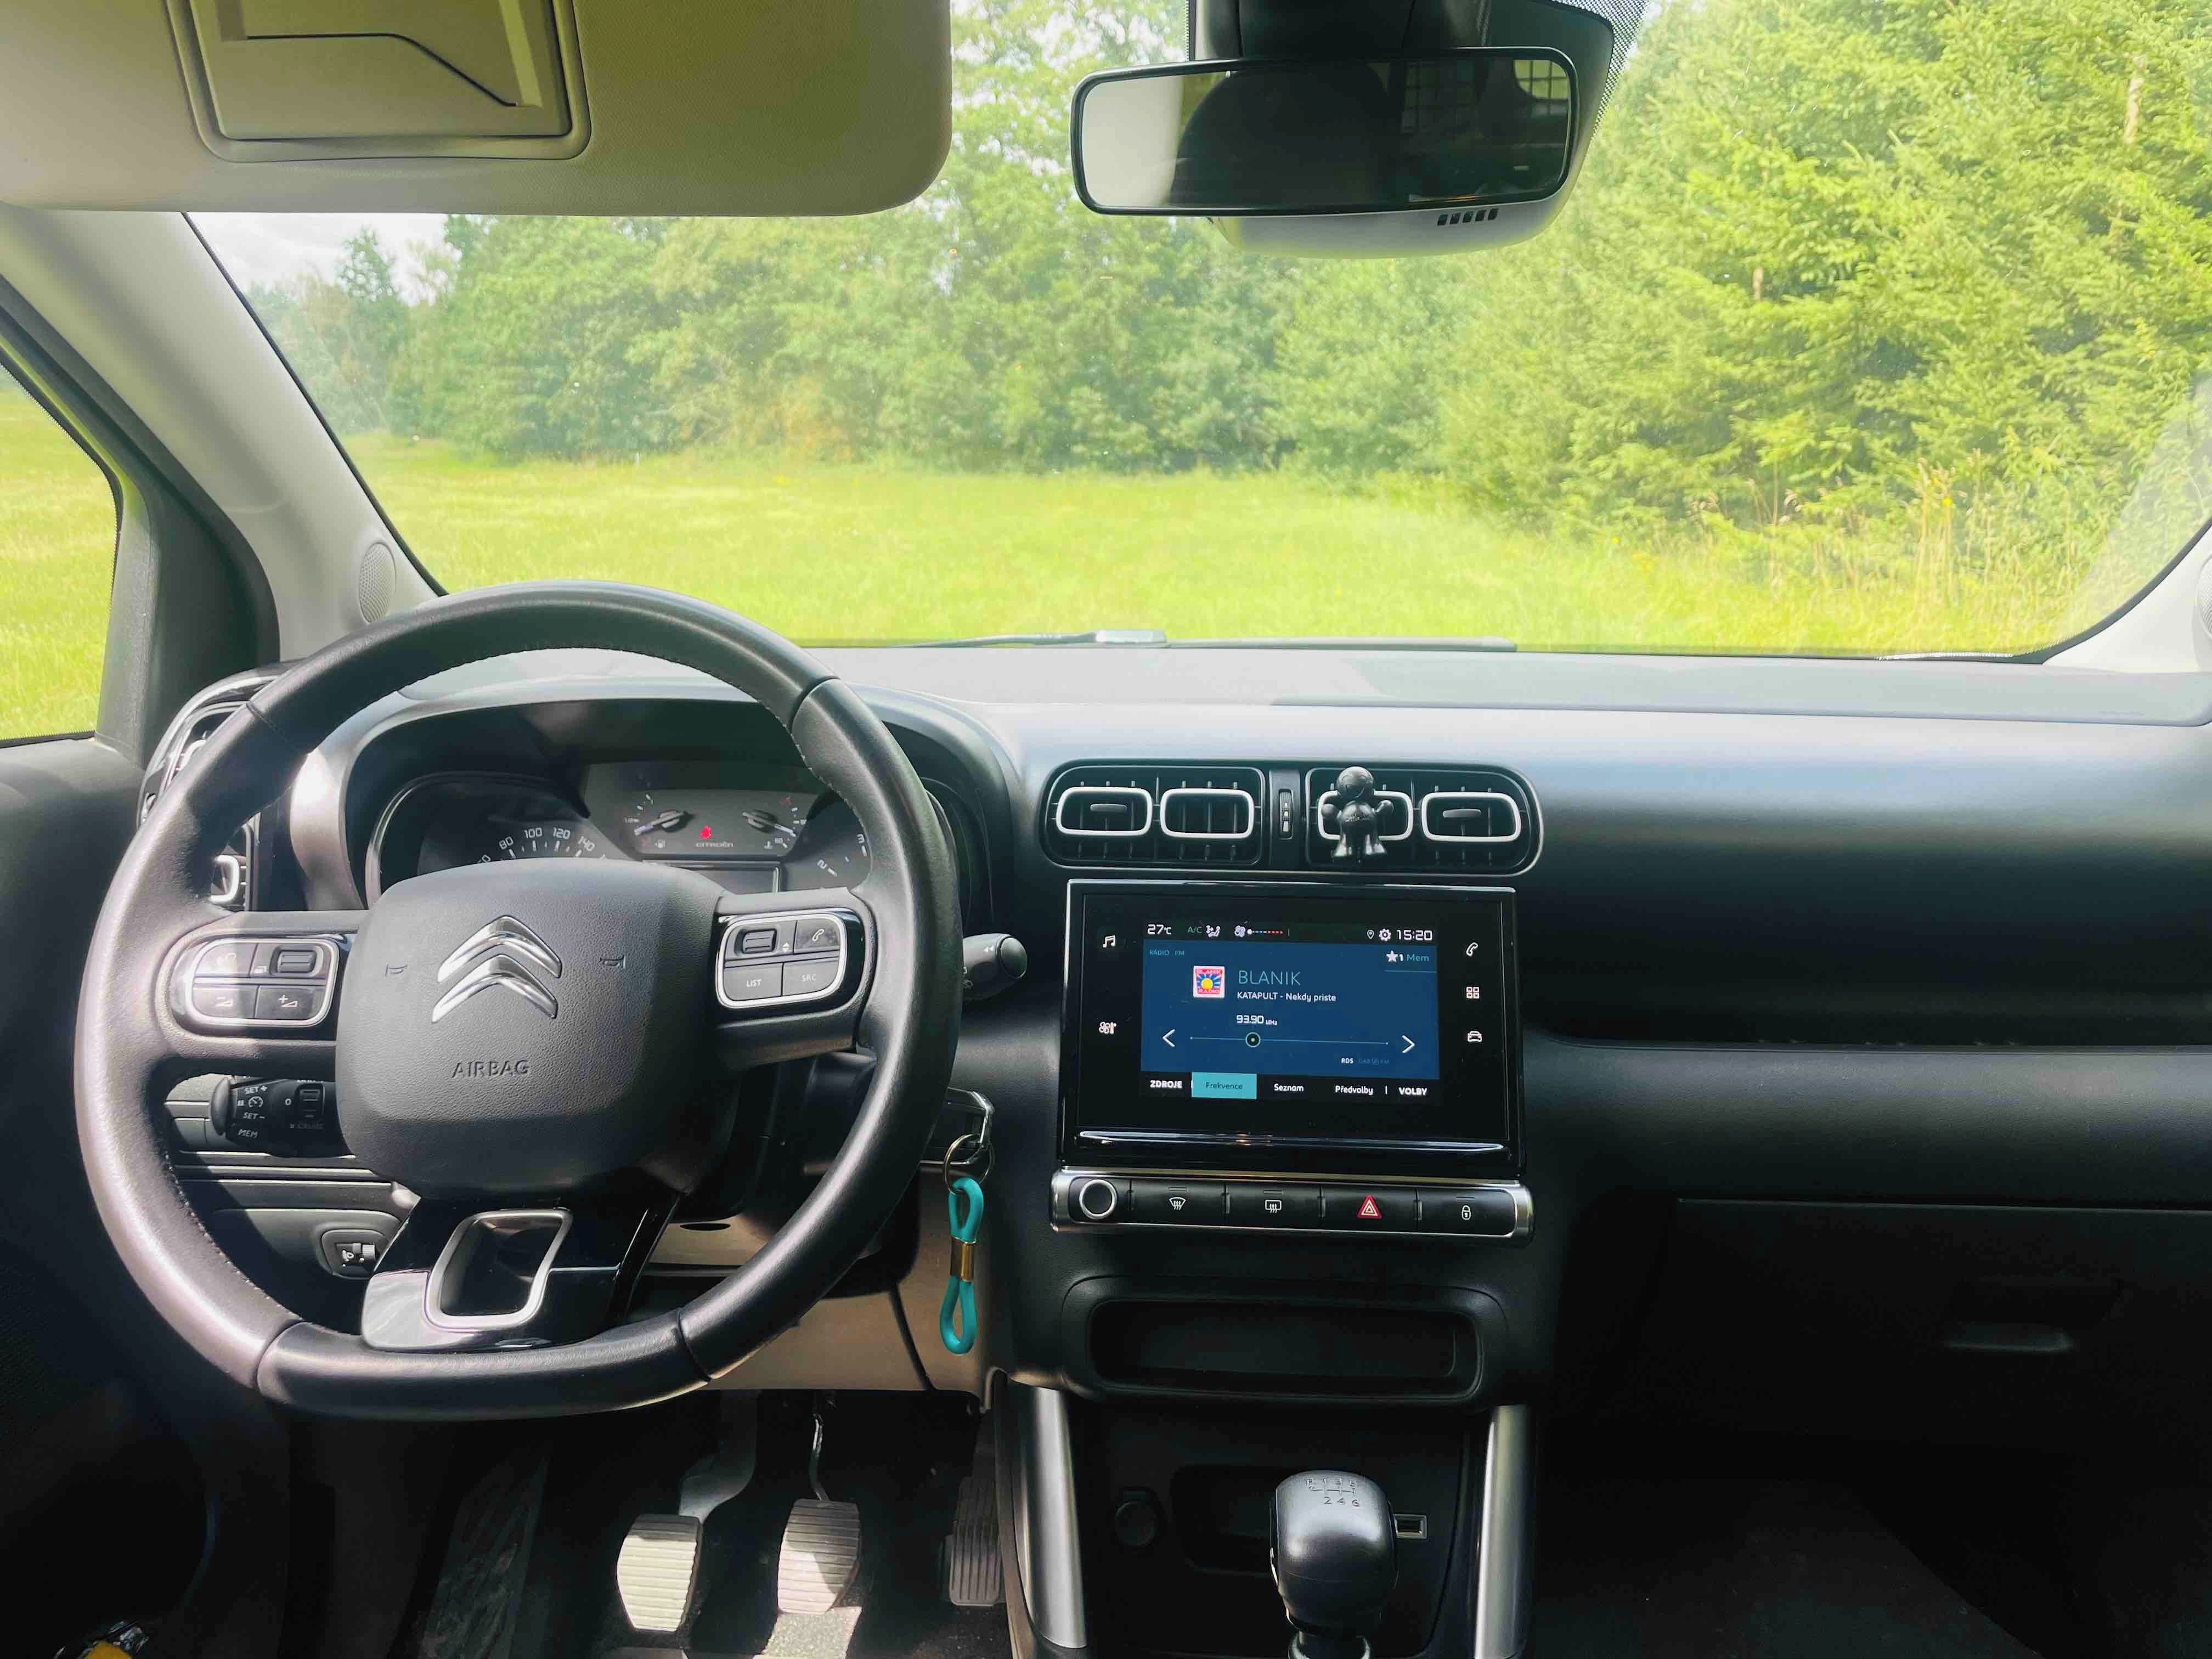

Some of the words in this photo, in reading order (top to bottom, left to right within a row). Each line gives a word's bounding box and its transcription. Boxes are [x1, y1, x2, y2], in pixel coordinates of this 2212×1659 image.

[524, 827, 543, 839] 100
[552, 827, 572, 840] 120
[498, 836, 515, 850] 80
[577, 836, 596, 852] 140
[817, 859, 828, 870] 2
[1187, 926, 1203, 934] A/C
[1396, 929, 1433, 941] 15:20
[1238, 969, 1301, 986] BLANIK
[746, 979, 762, 988] LIST
[1237, 991, 1278, 1000] KATAPULT
[1285, 993, 1312, 1002] Nekdy
[1313, 994, 1336, 1002] priste
[1235, 1014, 1265, 1025] 93.90
[452, 1059, 529, 1078] AIRBAG
[244, 1086, 259, 1094] SET
[1149, 1080, 1183, 1089] ZDROJE
[1205, 1081, 1243, 1090] Frekvence
[1274, 1083, 1304, 1092] Seznam
[1334, 1084, 1374, 1096] Předvolby
[1398, 1086, 1427, 1096] VOLBY
[242, 1111, 259, 1120] SET
[238, 1128, 259, 1138] MEM
[1323, 1496, 1333, 1505] 2
[1351, 1499, 1361, 1507] 6
